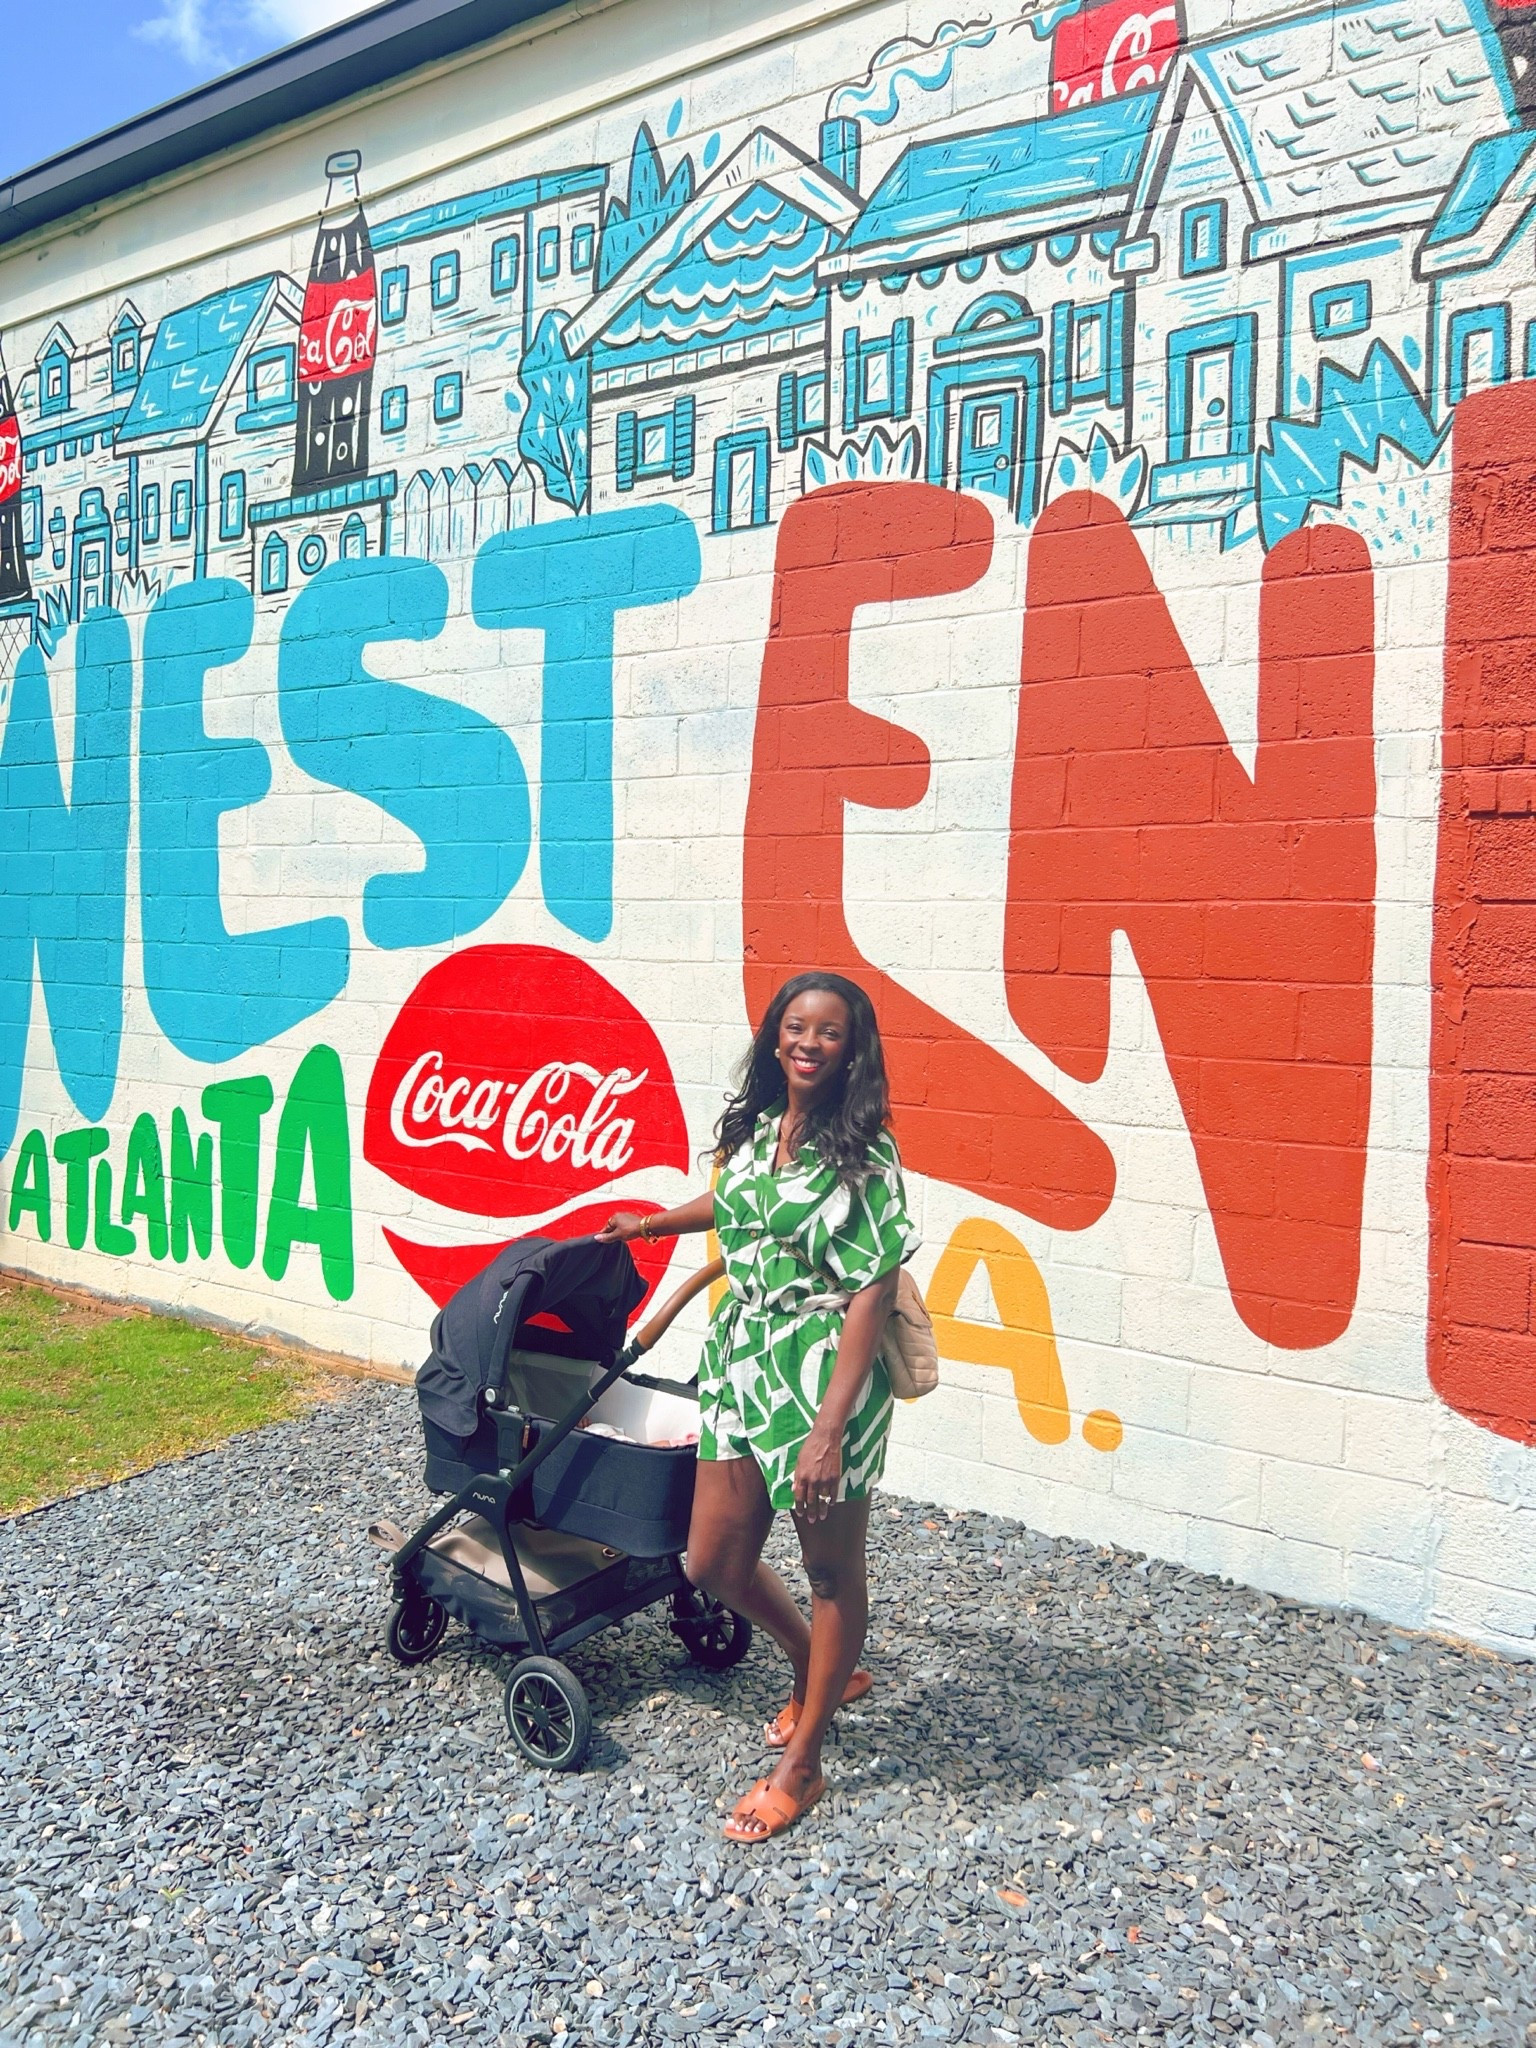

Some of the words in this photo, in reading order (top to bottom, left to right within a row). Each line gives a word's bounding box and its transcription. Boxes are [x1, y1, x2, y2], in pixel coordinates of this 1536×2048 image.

[743, 380, 1536, 1448] EN
[9, 1044, 354, 1302] ATLANTA
[390, 1050, 649, 1172] Coca-Cola
[472, 1491, 496, 1504] nuna
